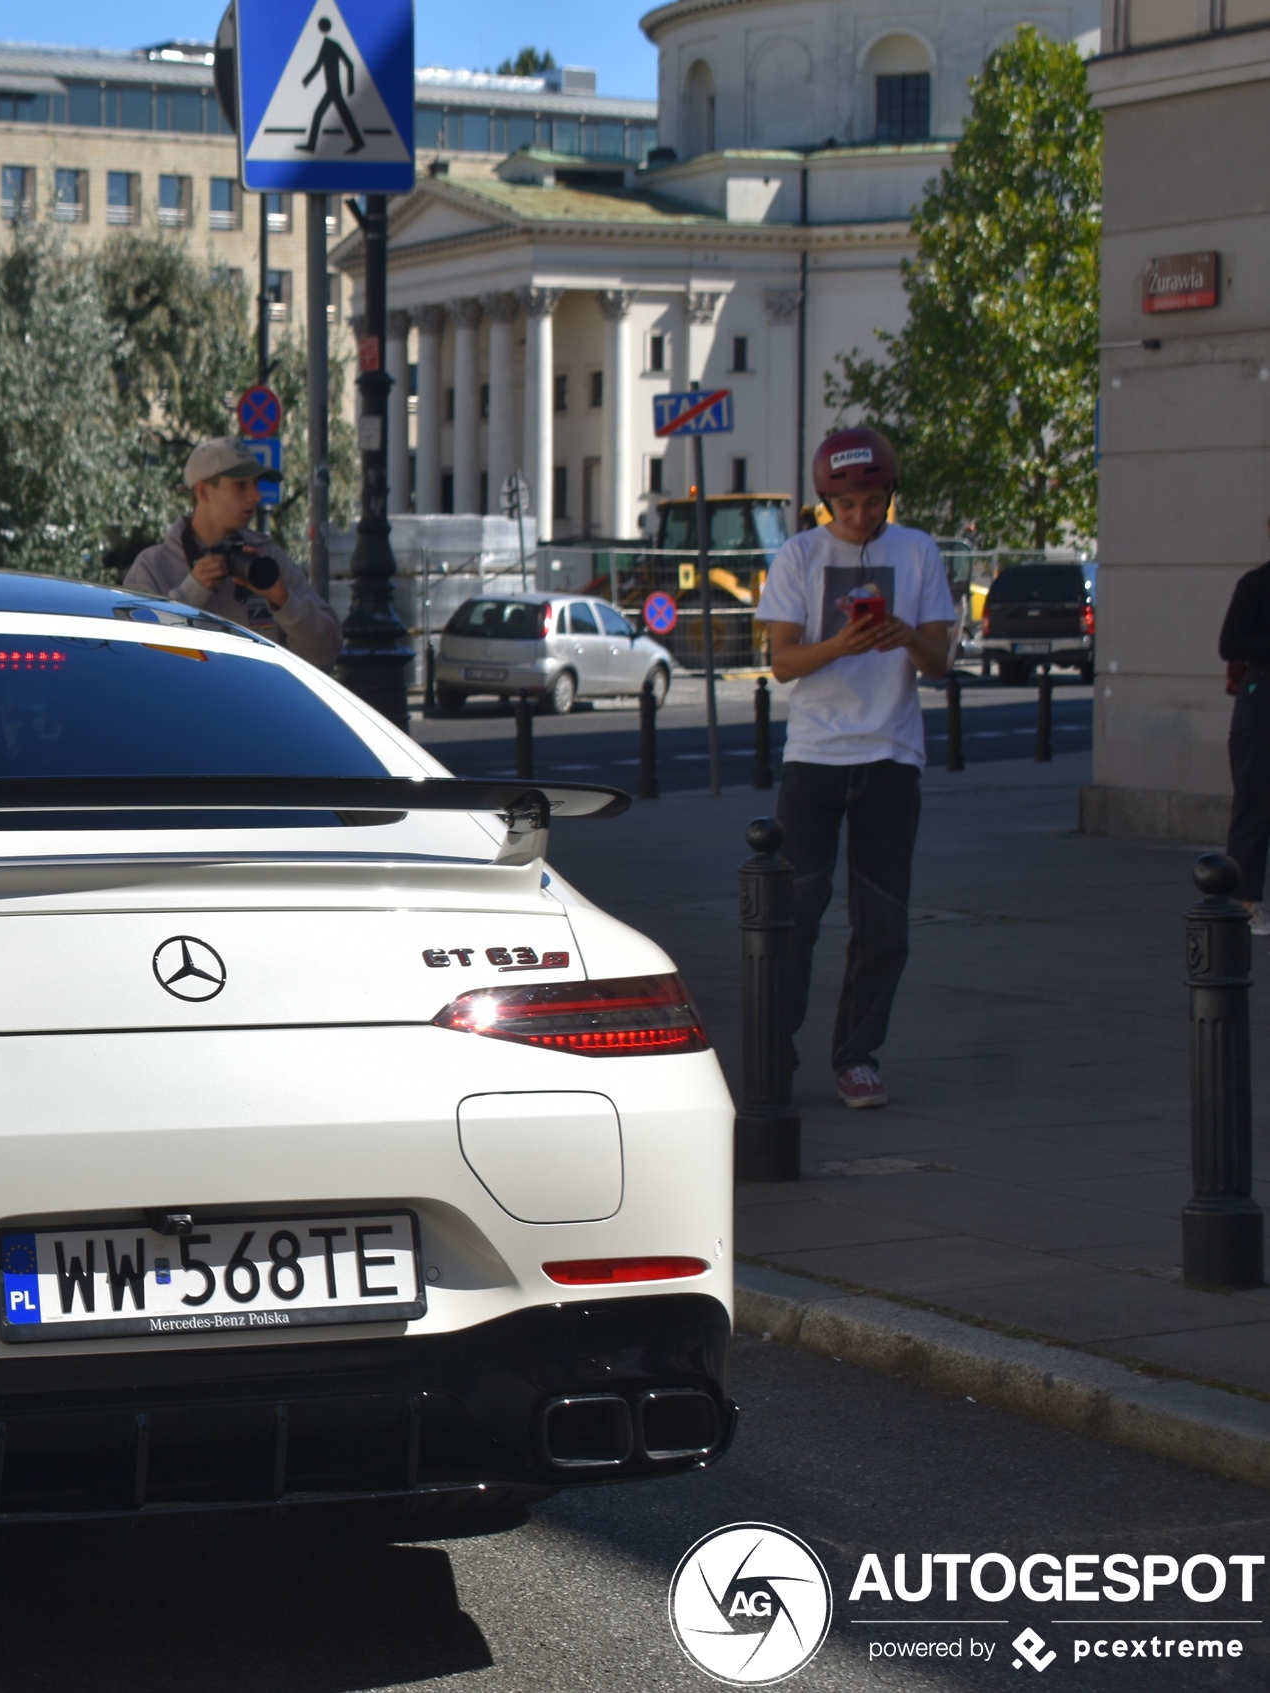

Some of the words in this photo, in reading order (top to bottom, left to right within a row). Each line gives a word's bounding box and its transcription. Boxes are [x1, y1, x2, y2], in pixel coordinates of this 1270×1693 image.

[1149, 266, 1204, 294] Żurawia
[657, 395, 729, 431] TAXI
[422, 947, 475, 968] GT
[54, 1237, 146, 1314] WW
[179, 1225, 398, 1307] 568TE
[10, 1290, 36, 1311] PL
[149, 1314, 245, 1331] Mercedes-Benz
[248, 1311, 290, 1326] Polska
